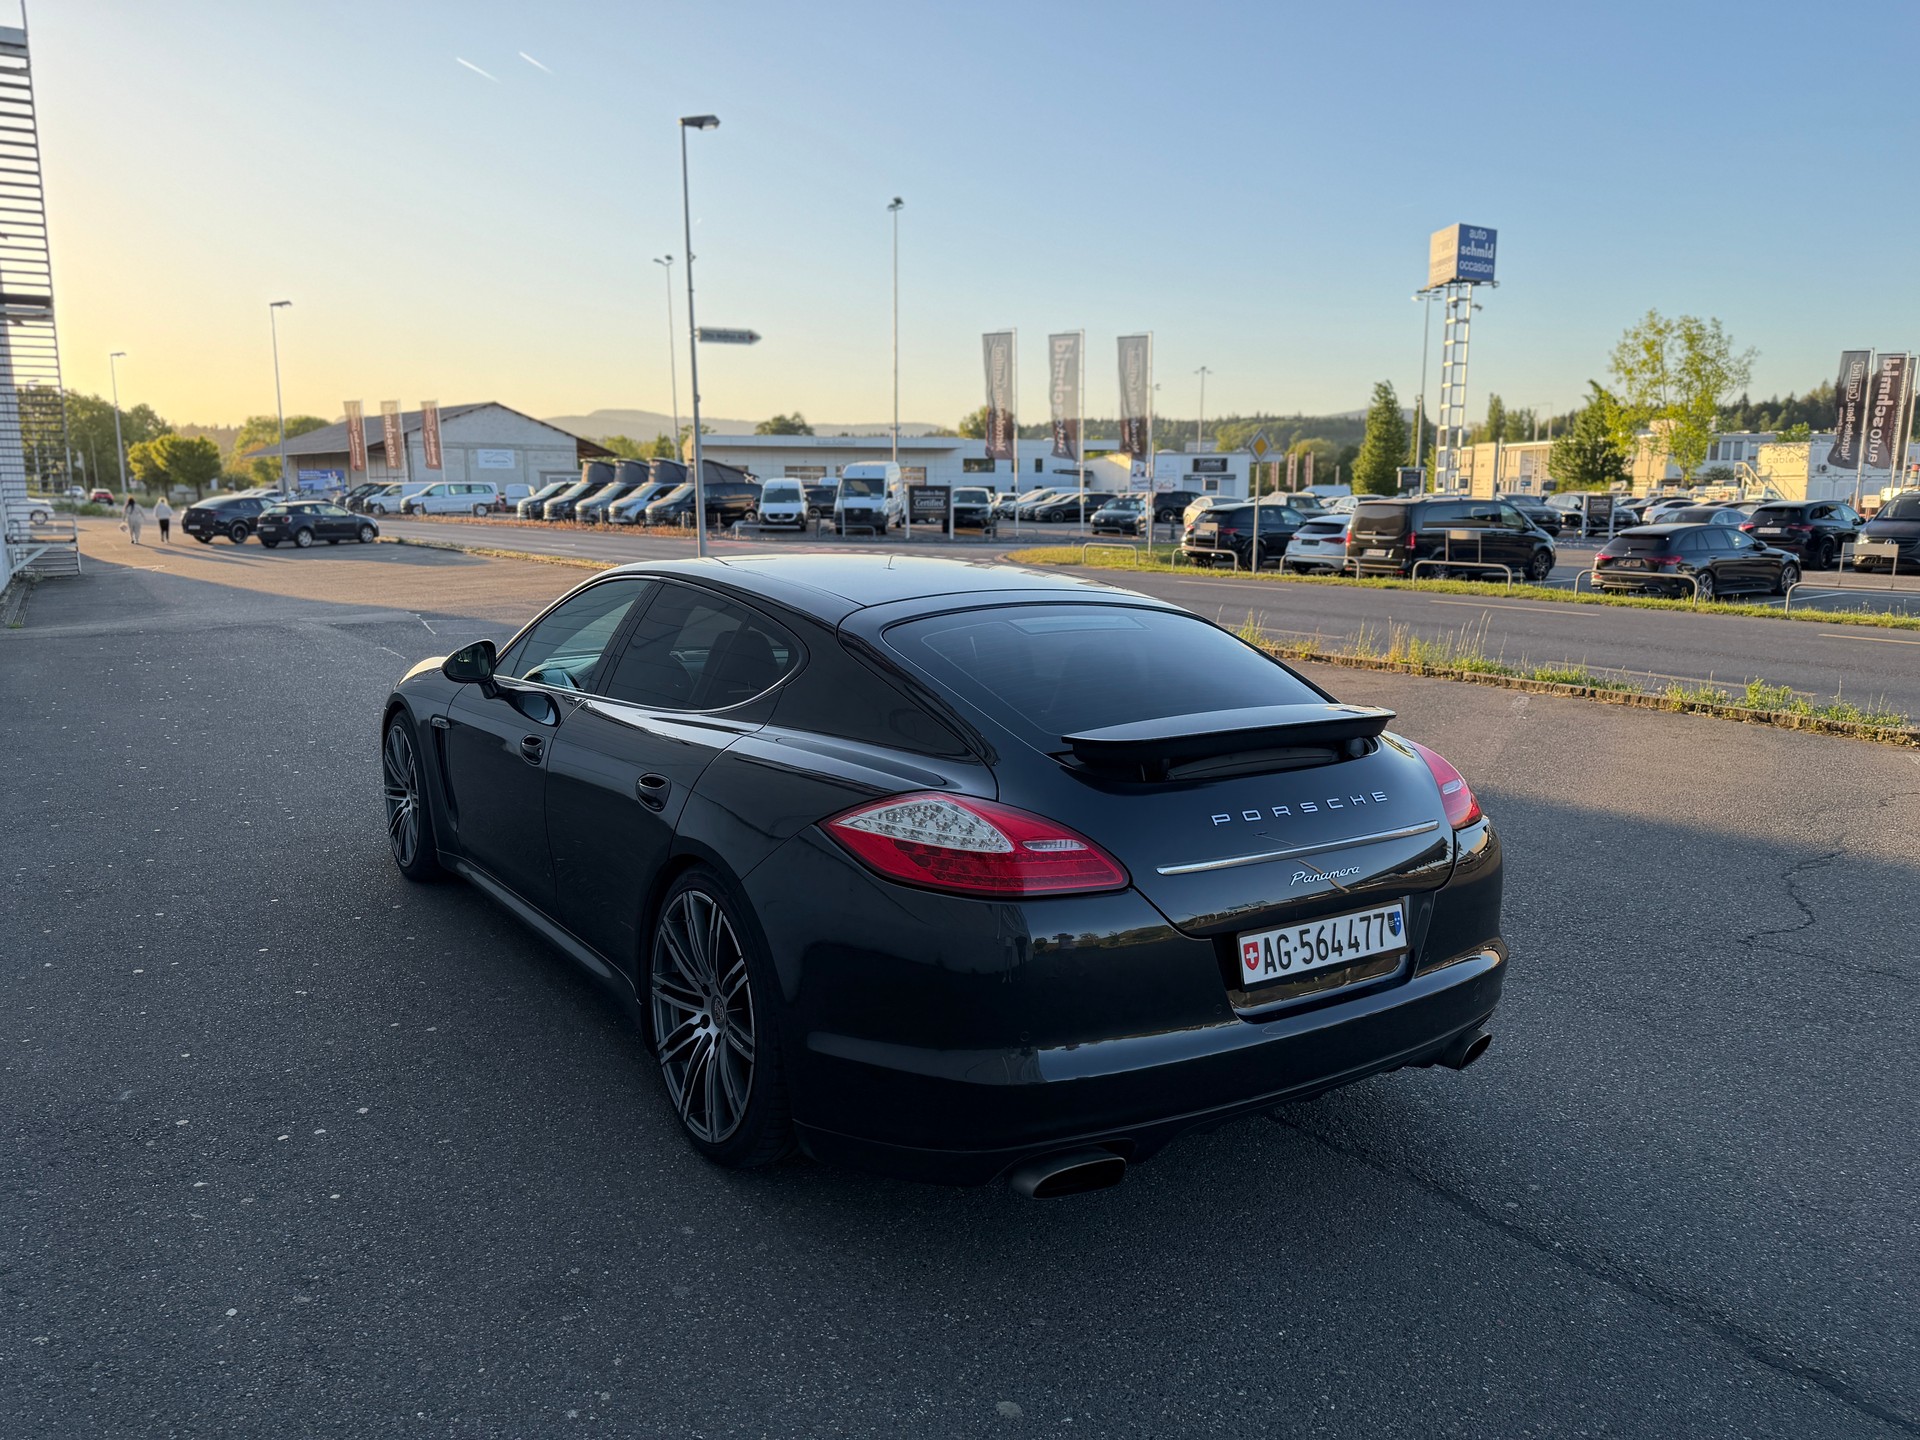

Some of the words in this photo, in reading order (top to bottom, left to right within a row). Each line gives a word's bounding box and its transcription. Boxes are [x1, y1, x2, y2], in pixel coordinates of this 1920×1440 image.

[1469, 229, 1487, 240] auto
[1460, 241, 1494, 258] schmid
[1459, 260, 1493, 273] occasion
[1211, 790, 1388, 827] PORSCHE
[1290, 863, 1361, 887] Panamera
